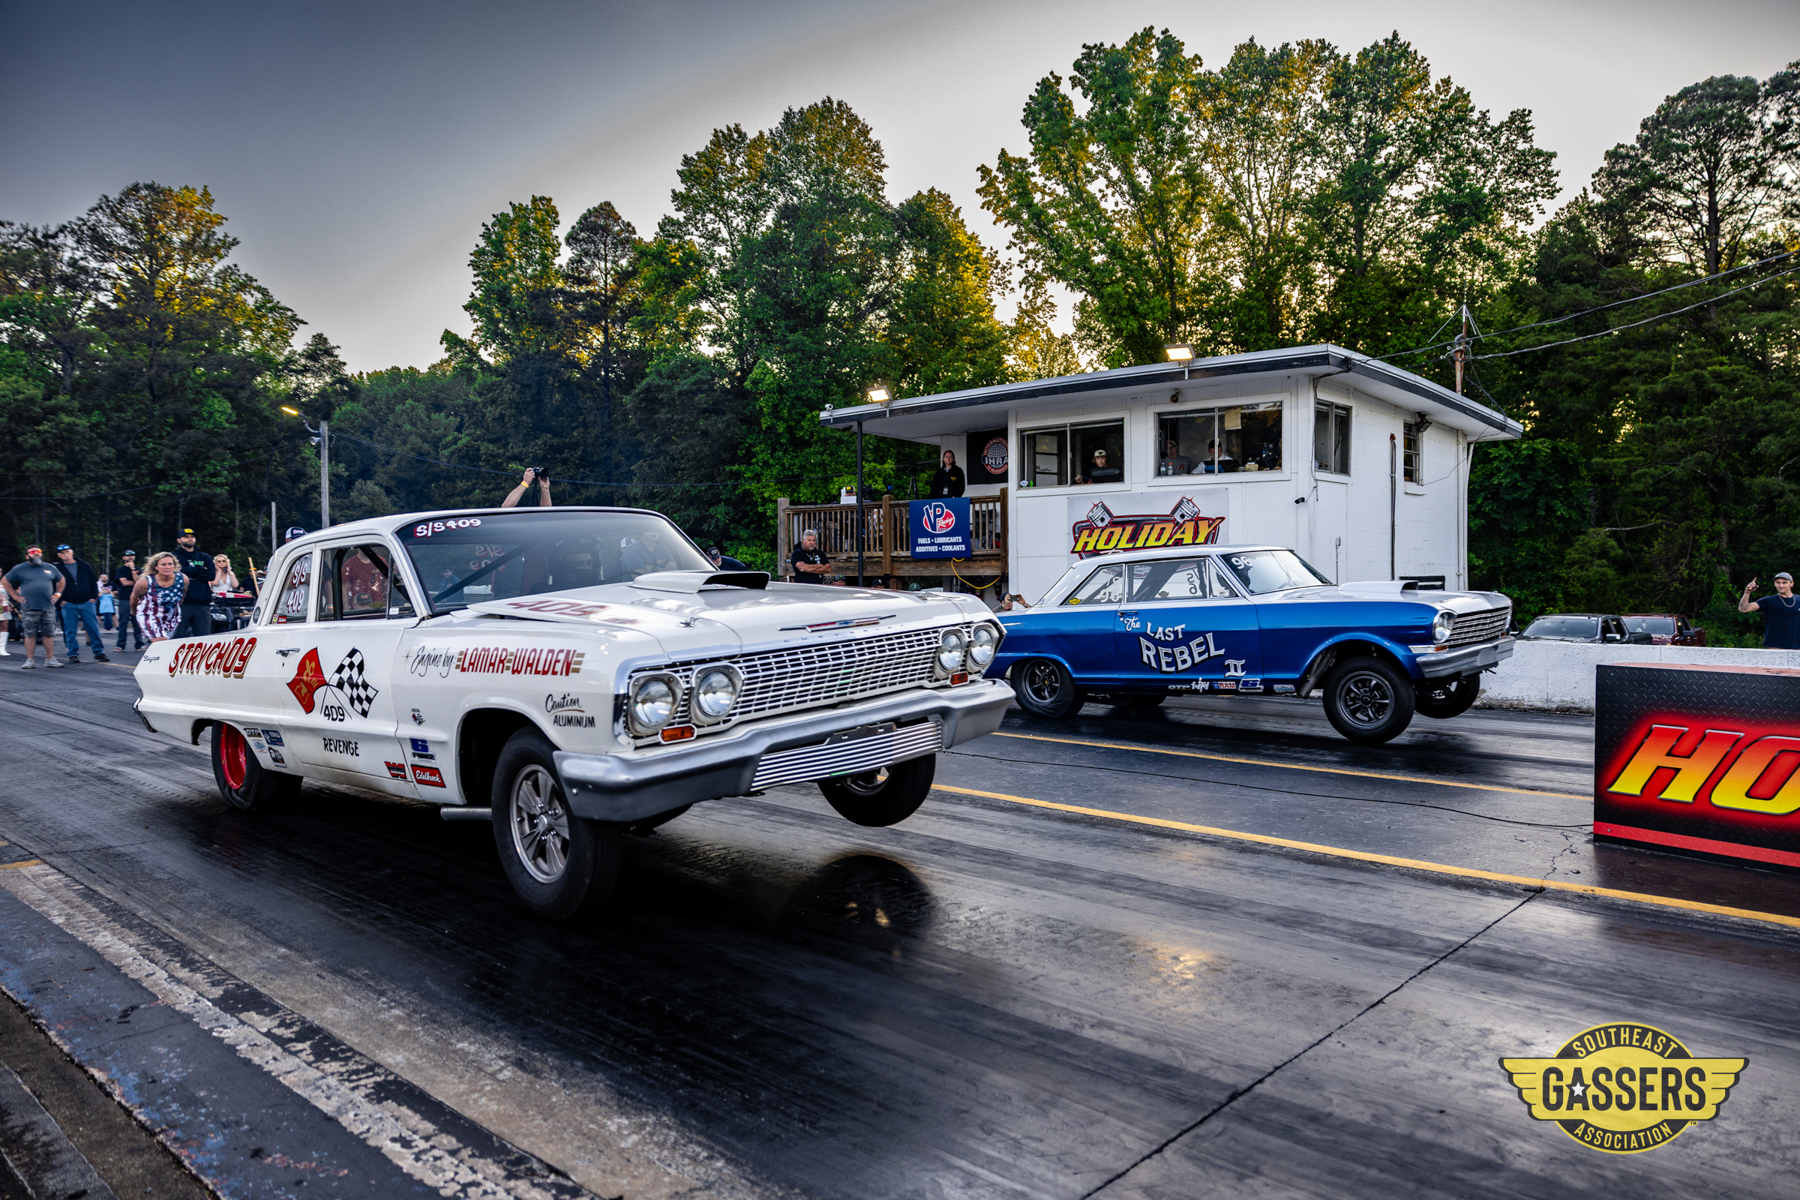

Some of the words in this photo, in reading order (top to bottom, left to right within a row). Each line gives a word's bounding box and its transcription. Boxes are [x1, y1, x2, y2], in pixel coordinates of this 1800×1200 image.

[984, 456, 1008, 465] IHRA
[923, 502, 946, 533] VP
[934, 536, 962, 544] LUBRICANTS
[1072, 517, 1224, 553] HOLIDAY
[1231, 556, 1254, 570] 96
[292, 561, 308, 589] S/S
[287, 589, 305, 613] 409
[507, 600, 608, 616] 409
[1124, 616, 1141, 632] The
[1145, 621, 1186, 641] LAST
[411, 645, 441, 678] Engine
[460, 647, 507, 674] LAMAR
[511, 648, 577, 677] WALDEN
[1138, 632, 1226, 674] REBEL
[1224, 659, 1246, 677] II
[545, 693, 583, 713] Caution
[323, 705, 345, 722] 409
[553, 715, 596, 729] ALUMINUM
[322, 737, 360, 757] REVENGE
